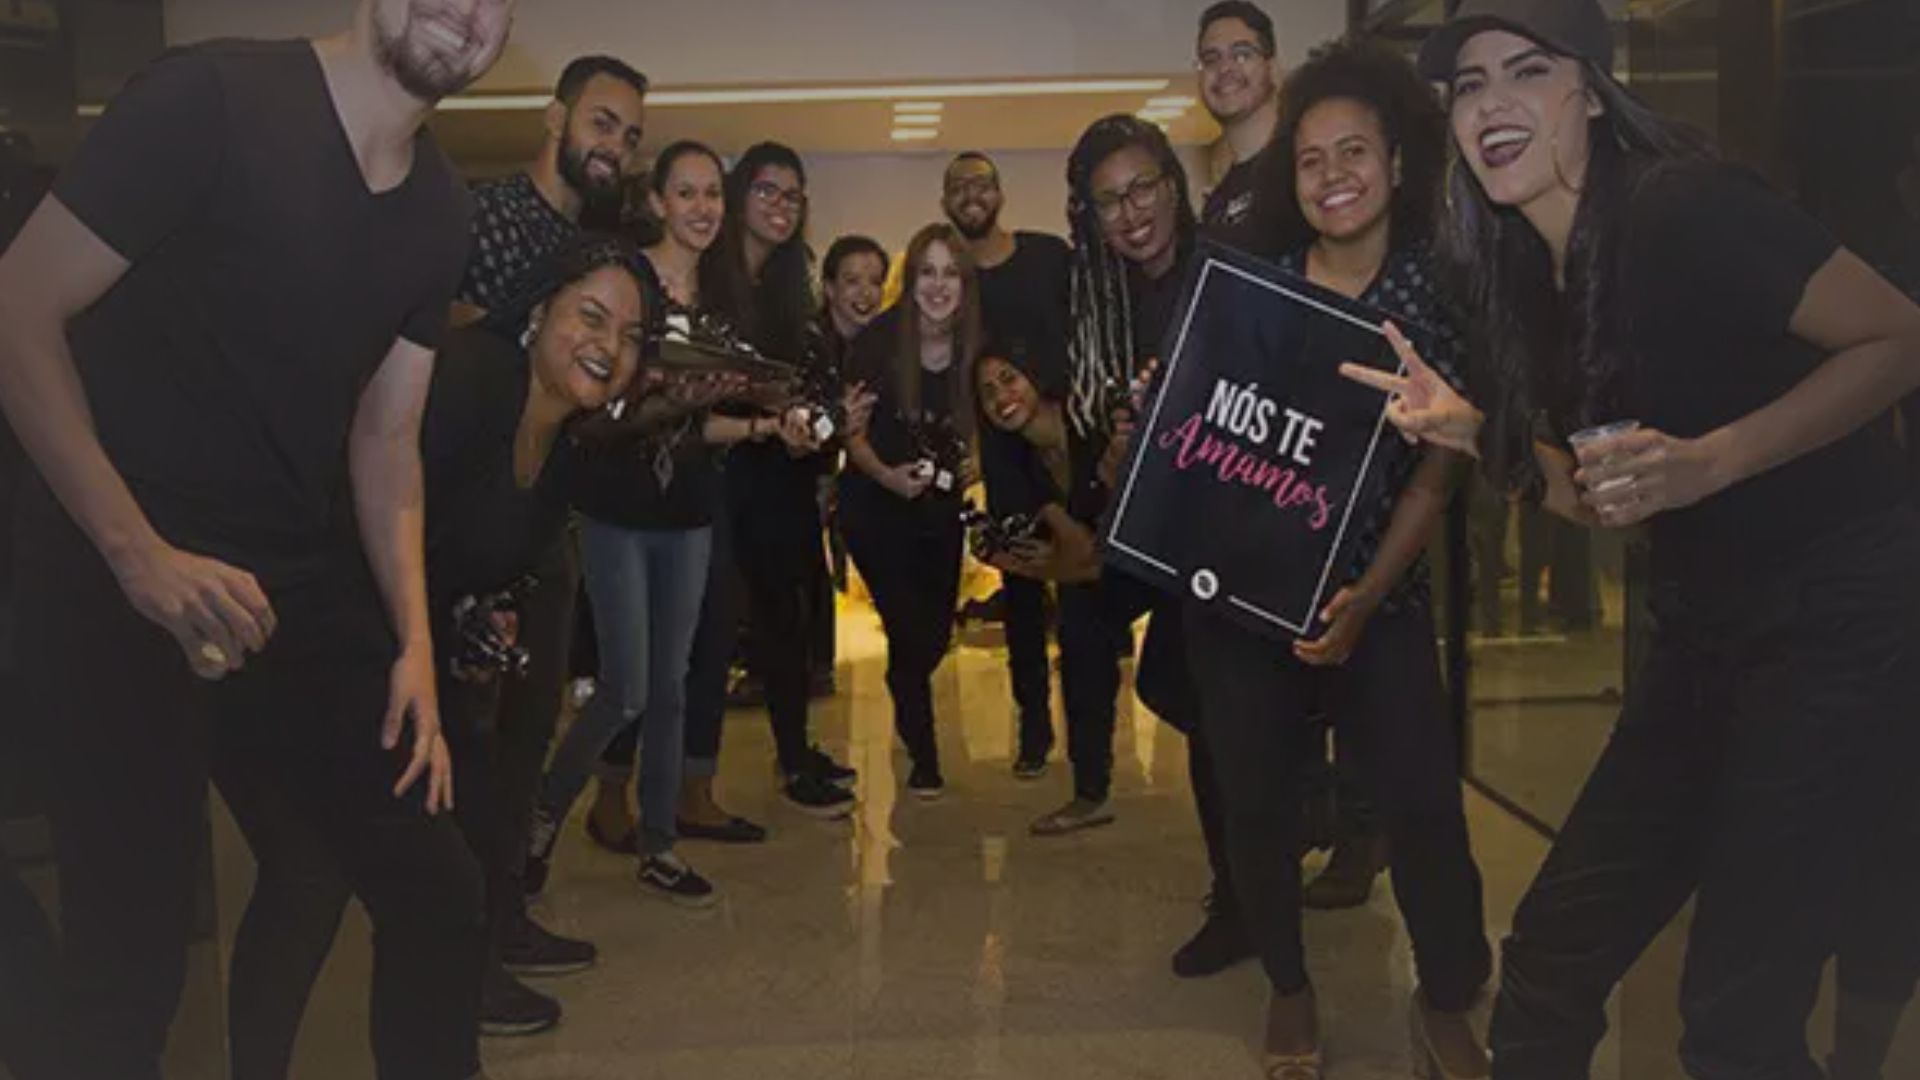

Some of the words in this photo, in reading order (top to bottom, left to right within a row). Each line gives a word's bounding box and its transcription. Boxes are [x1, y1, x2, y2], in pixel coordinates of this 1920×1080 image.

[1158, 412, 1335, 530] Amamos
[1206, 378, 1277, 444] NÓS
[1277, 408, 1324, 466] TE
